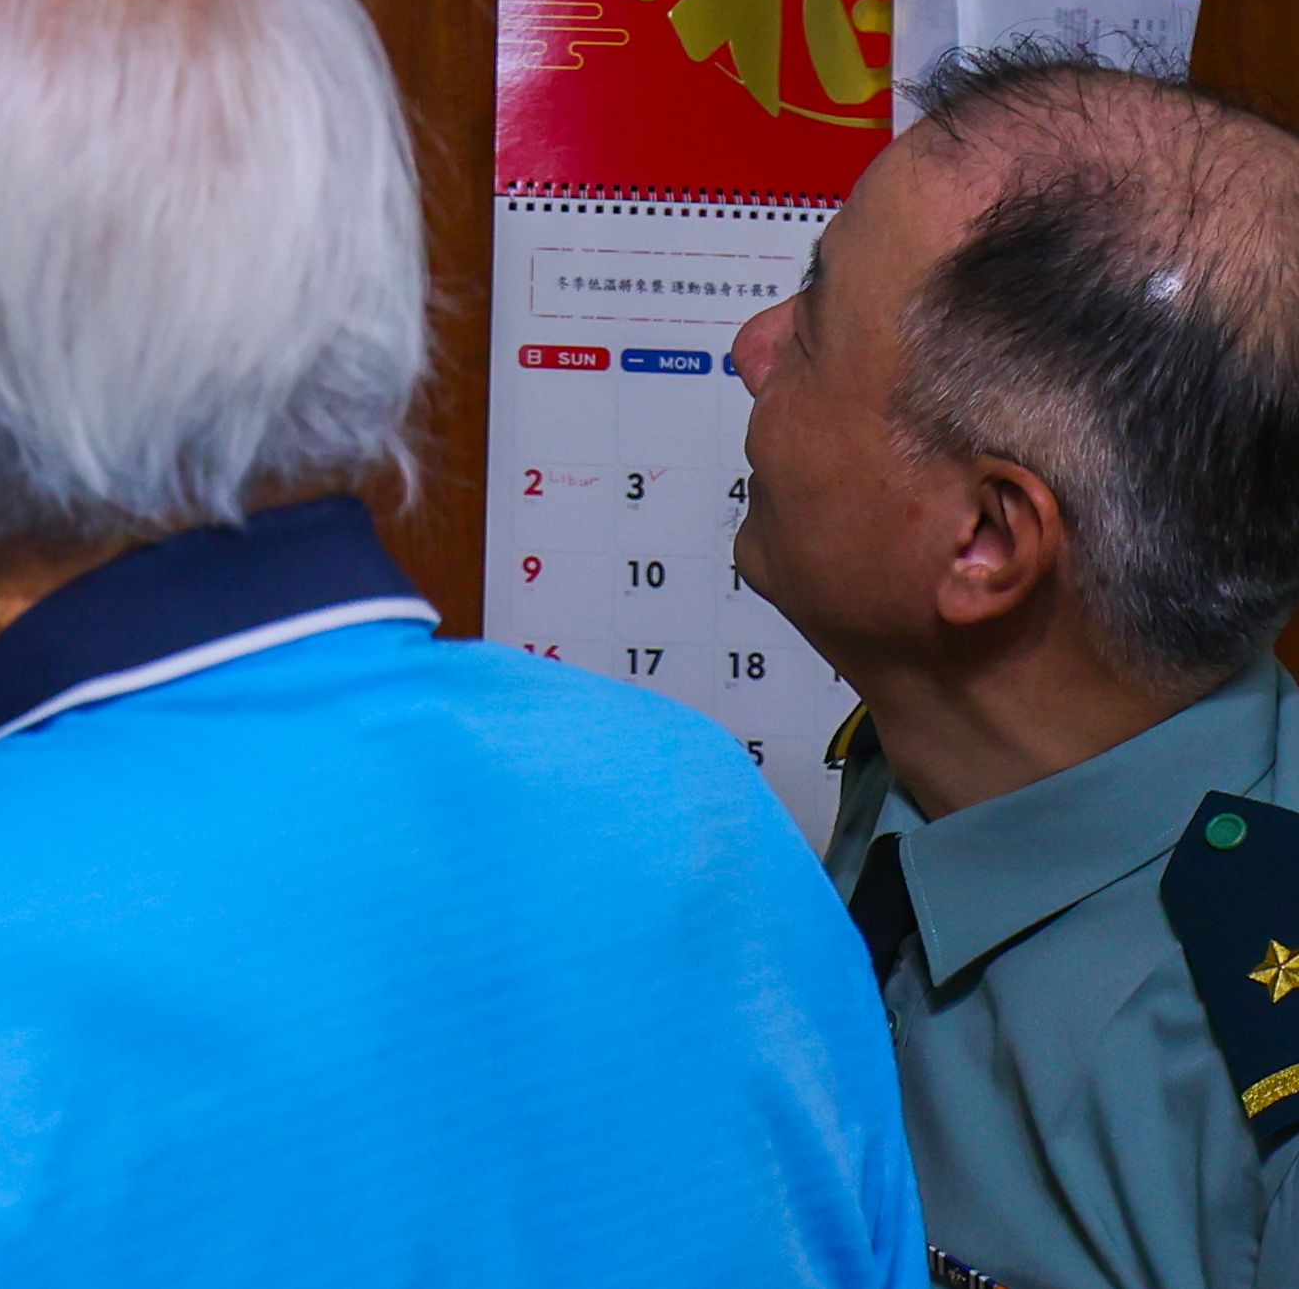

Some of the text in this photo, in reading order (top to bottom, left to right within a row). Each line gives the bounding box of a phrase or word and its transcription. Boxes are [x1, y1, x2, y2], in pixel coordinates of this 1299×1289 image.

[557, 275, 780, 299] 冬季低溫將來襲 運動強身不畏寒
[558, 351, 597, 367] SUN
[658, 356, 701, 371] MON
[523, 468, 543, 496] 2
[626, 472, 645, 500] 3
[728, 477, 747, 504] 4
[522, 555, 543, 584] 9
[626, 559, 666, 588] 10
[625, 647, 665, 676] 17
[728, 651, 767, 680] 18
